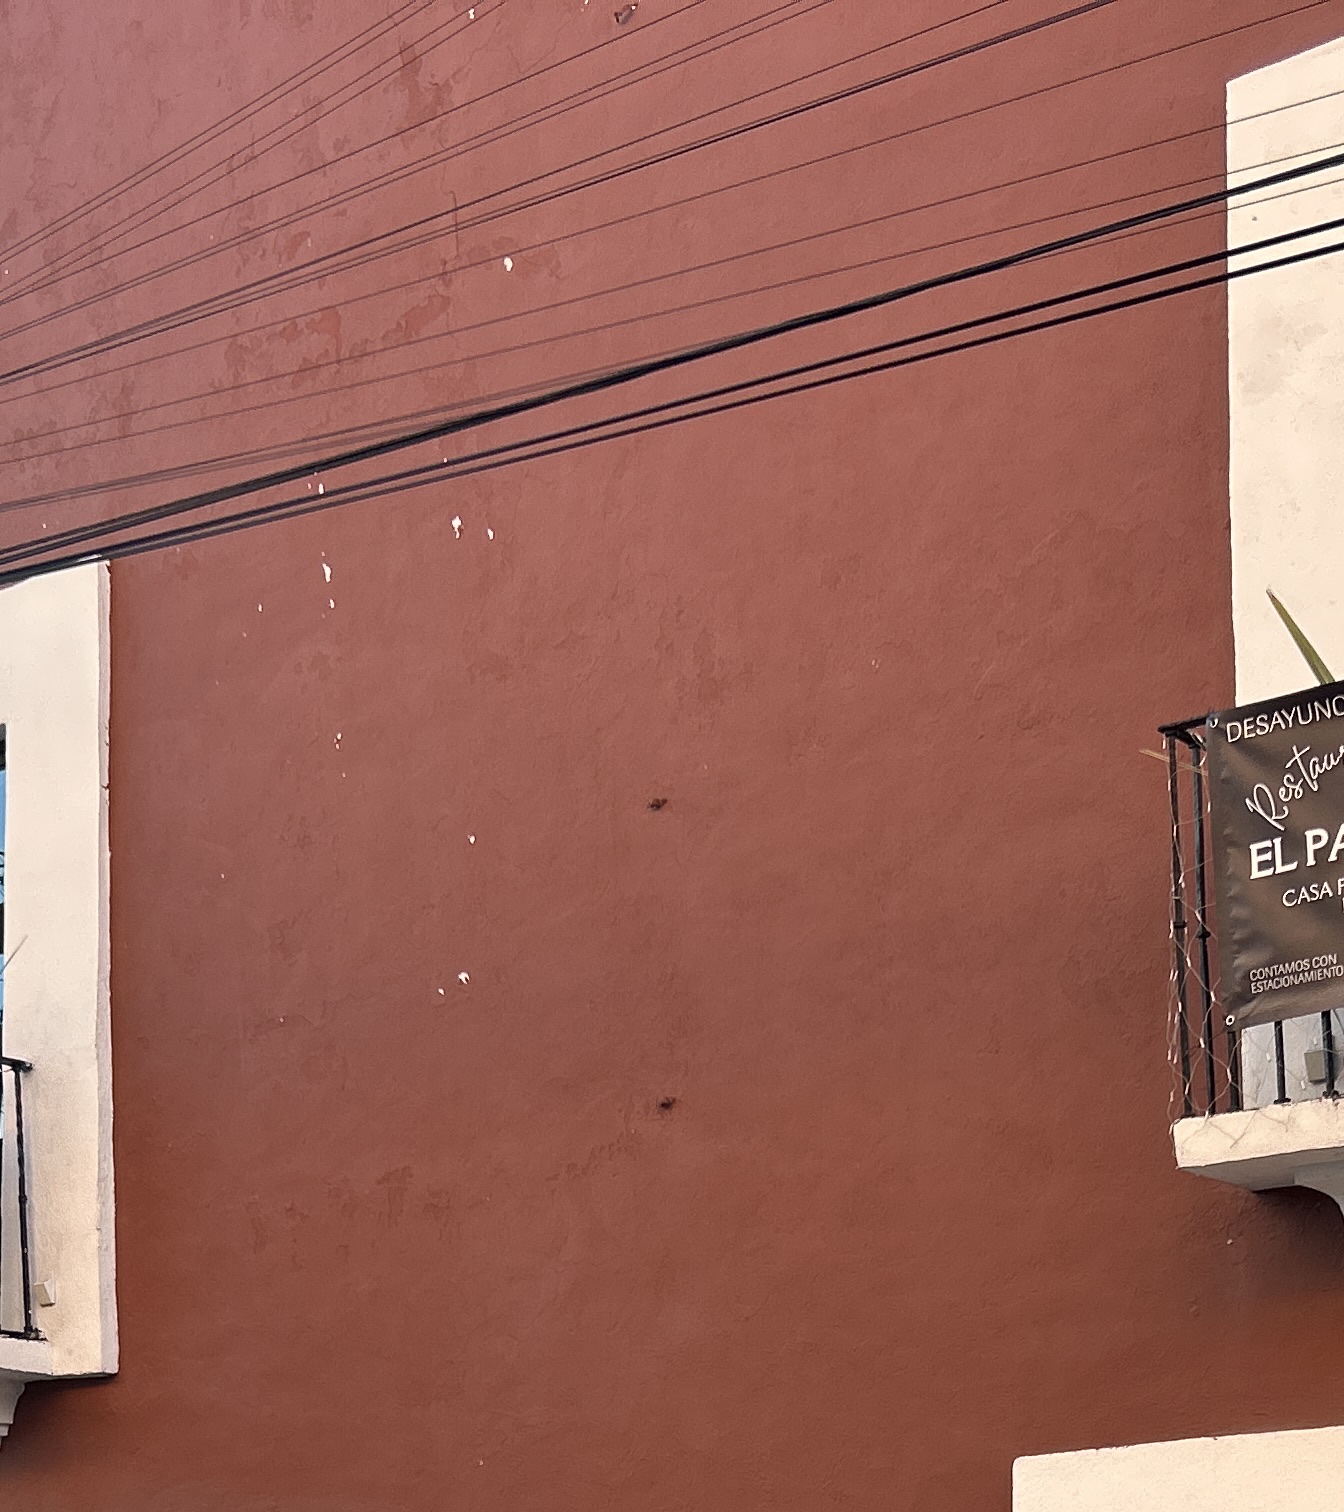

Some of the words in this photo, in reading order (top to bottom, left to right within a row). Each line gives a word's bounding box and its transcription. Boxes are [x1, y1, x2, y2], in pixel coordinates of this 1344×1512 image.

[1249, 837, 1298, 880] EL
[1282, 881, 1333, 907] CASA
[1249, 961, 1310, 982] CONTAMOS
[1312, 953, 1338, 970] CON
[1250, 965, 1344, 994] ESTACIONAMIENTO
